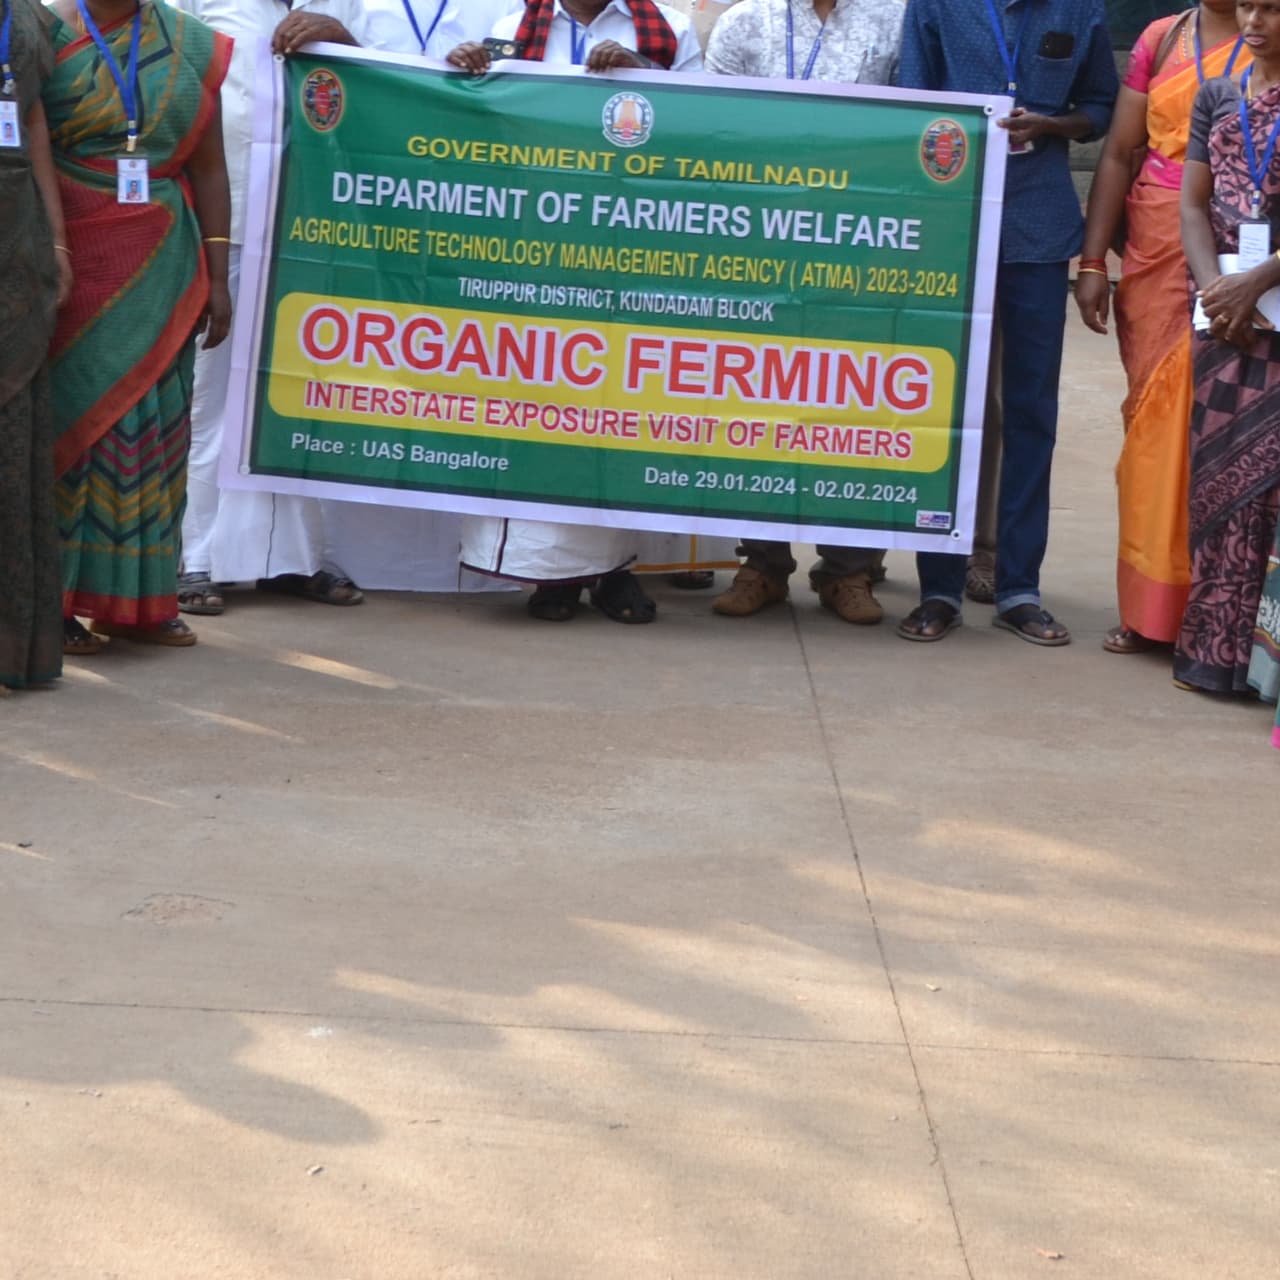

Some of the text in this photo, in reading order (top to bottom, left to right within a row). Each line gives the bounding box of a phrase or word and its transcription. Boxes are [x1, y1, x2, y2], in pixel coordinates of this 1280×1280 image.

[407, 135, 849, 190] GOVERNMENT OF TAMILNADU
[332, 171, 921, 251] DEPARMENT OF FARMERS WELFARE
[289, 217, 420, 254] AGRICULTURE
[426, 231, 554, 266] TECHNOLOGY
[559, 244, 699, 278] MANAGEMENT
[702, 254, 786, 285] AGENCY
[866, 267, 958, 298] 2023-2024
[458, 276, 774, 322] TIRUPPUR DISTRICT, KUNDADAM BLOCK
[301, 306, 930, 411] ORGANIC FERMING
[291, 433, 344, 456] Place
[362, 439, 405, 460] UAS
[410, 445, 509, 471] Bangalore
[305, 380, 912, 459] INTERSTATE EXPOSURE VISIT OF FARMERS
[644, 467, 689, 487] Date
[695, 470, 796, 495] 29.01.2024
[813, 479, 918, 503] 02.02.2024
